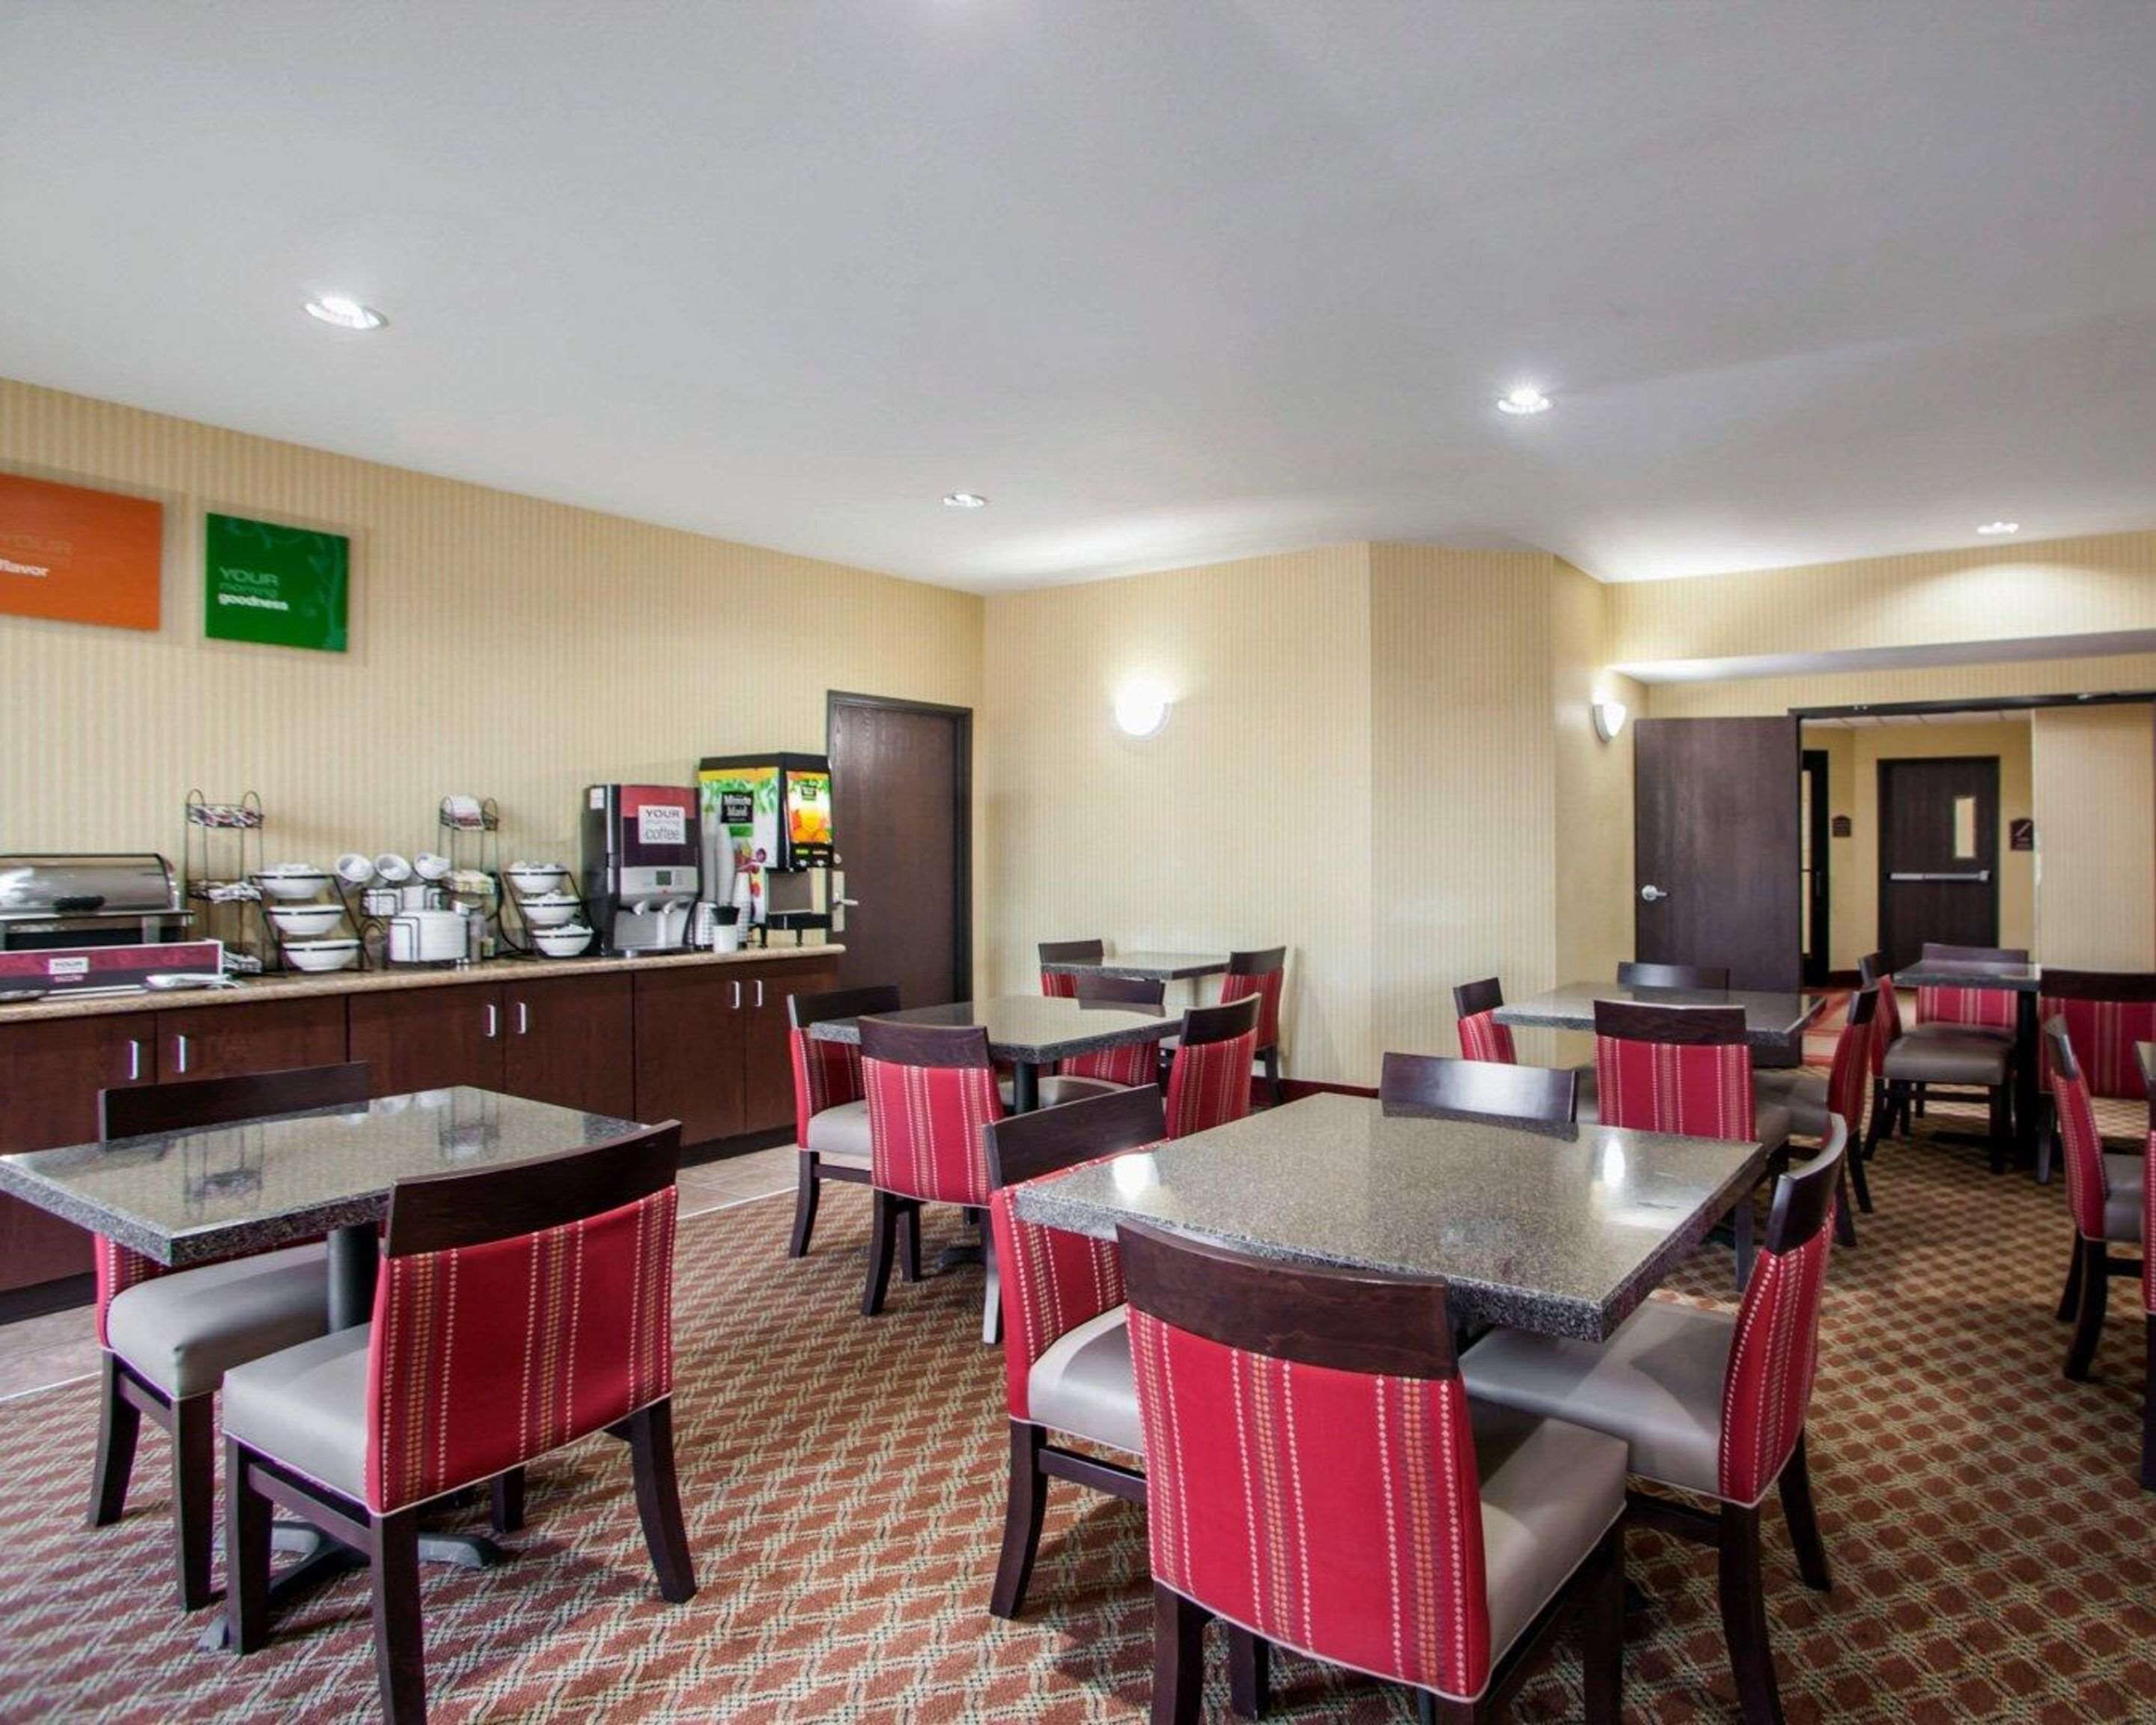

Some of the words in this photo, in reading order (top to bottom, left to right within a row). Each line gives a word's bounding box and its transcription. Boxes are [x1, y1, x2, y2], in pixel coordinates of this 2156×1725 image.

[219, 566, 279, 586] YOUR
[218, 594, 289, 610] goodness
[646, 809, 680, 818] YOUR
[645, 827, 680, 840] coffee
